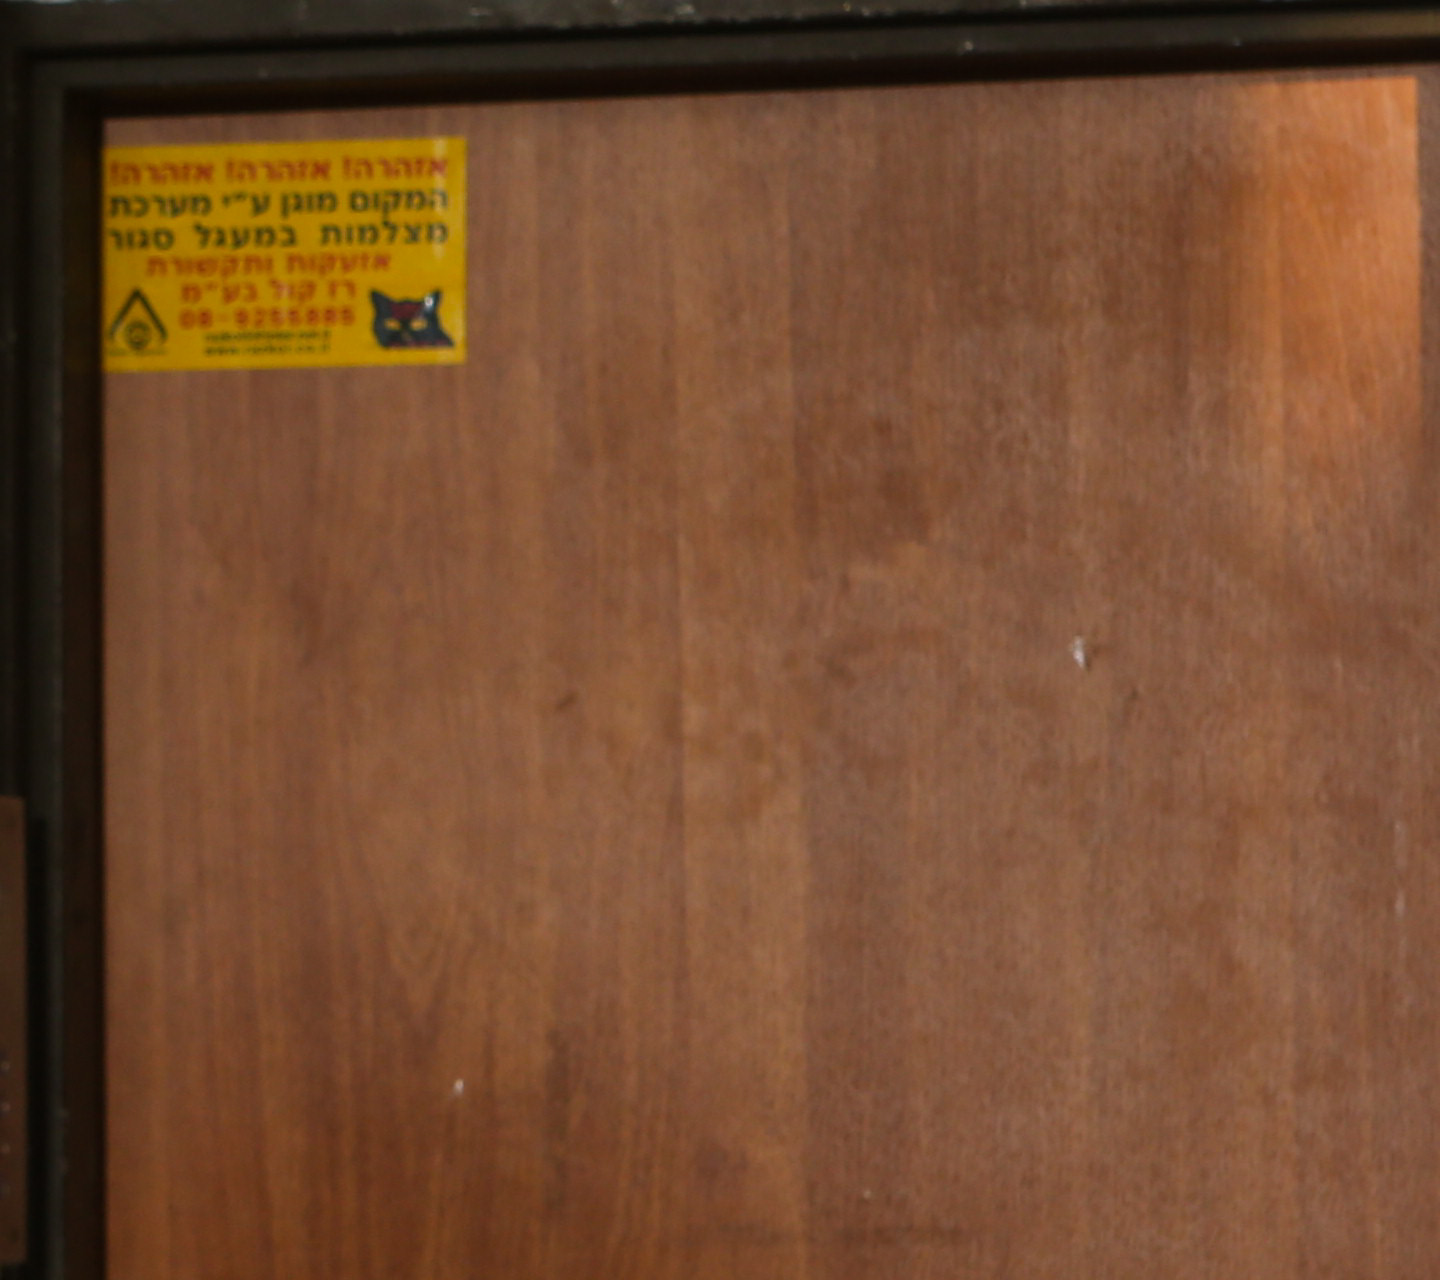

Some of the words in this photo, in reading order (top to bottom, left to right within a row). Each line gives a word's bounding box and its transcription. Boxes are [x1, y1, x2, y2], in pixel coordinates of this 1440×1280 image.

[109, 161, 214, 186] אזהרה!
[226, 159, 330, 184] אזהרה!
[343, 157, 448, 182] אזהרה!
[109, 193, 213, 219] מערכת
[281, 192, 338, 218] מוגן
[349, 188, 449, 220] המקום
[109, 227, 175, 251] סגור
[194, 223, 297, 251] במעגל
[320, 221, 449, 246] מצלמות
